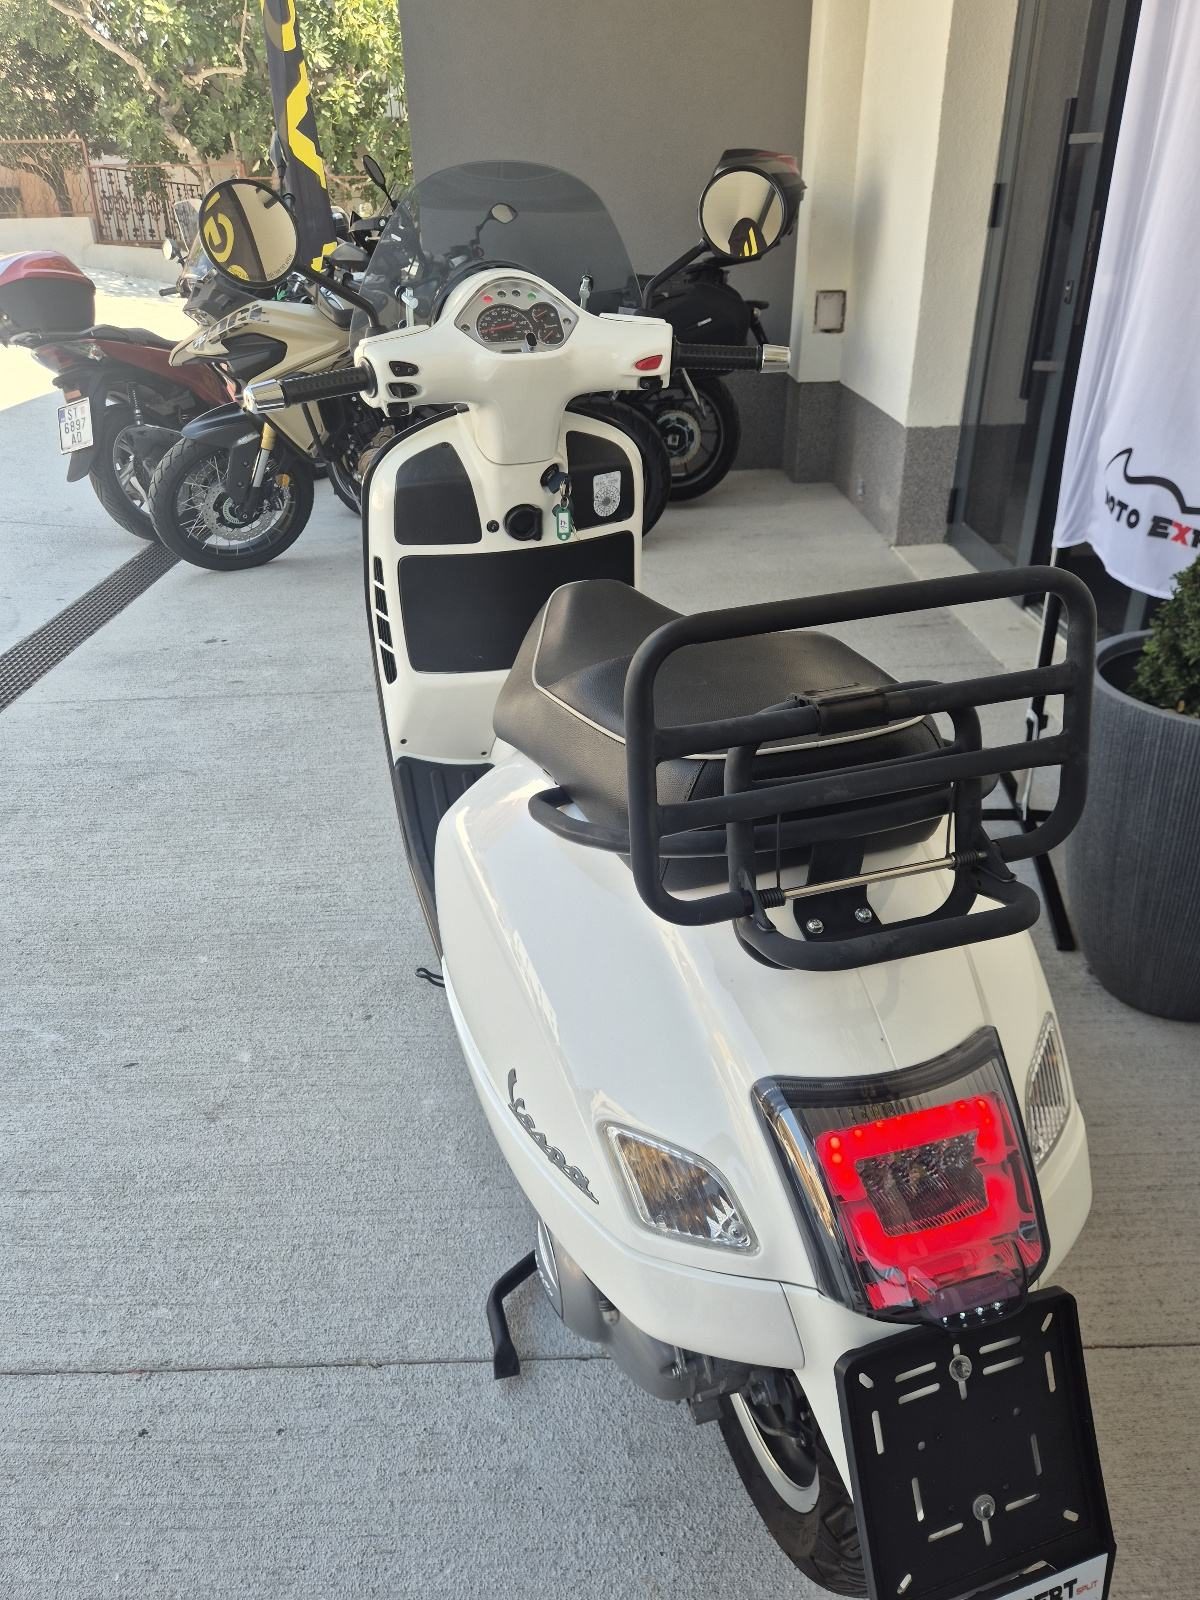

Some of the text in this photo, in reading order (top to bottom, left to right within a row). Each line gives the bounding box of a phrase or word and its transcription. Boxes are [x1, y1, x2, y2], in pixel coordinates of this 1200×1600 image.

[67, 407, 78, 421] ST
[64, 417, 86, 434] 6897
[507, 1067, 600, 1206] Vespa
